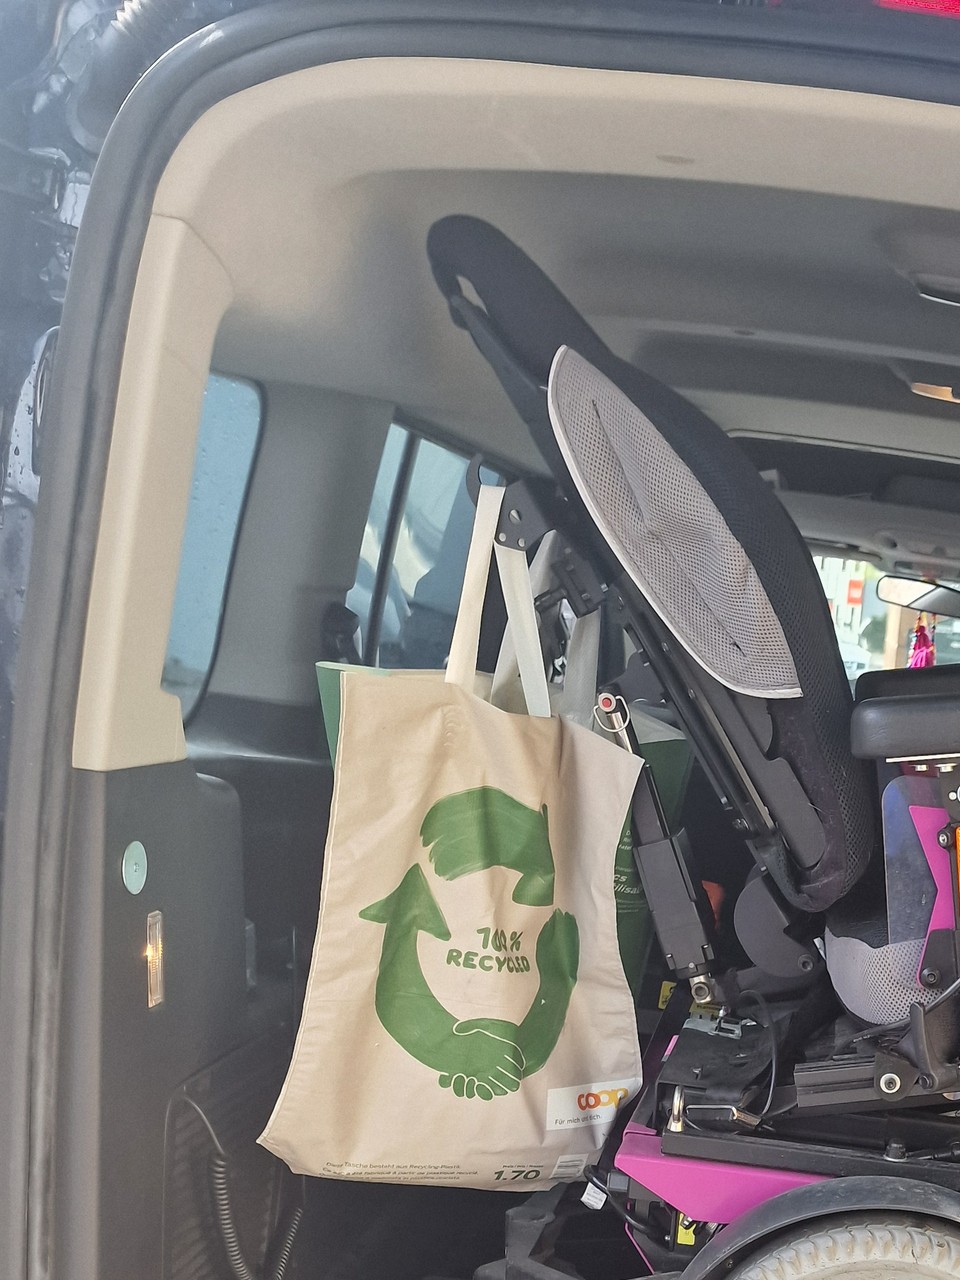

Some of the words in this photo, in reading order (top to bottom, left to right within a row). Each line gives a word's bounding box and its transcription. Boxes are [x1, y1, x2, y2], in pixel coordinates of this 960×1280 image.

[446, 949, 530, 973] RECYCLED
[577, 1087, 628, 1111] coop
[494, 1169, 540, 1181] 1.70
